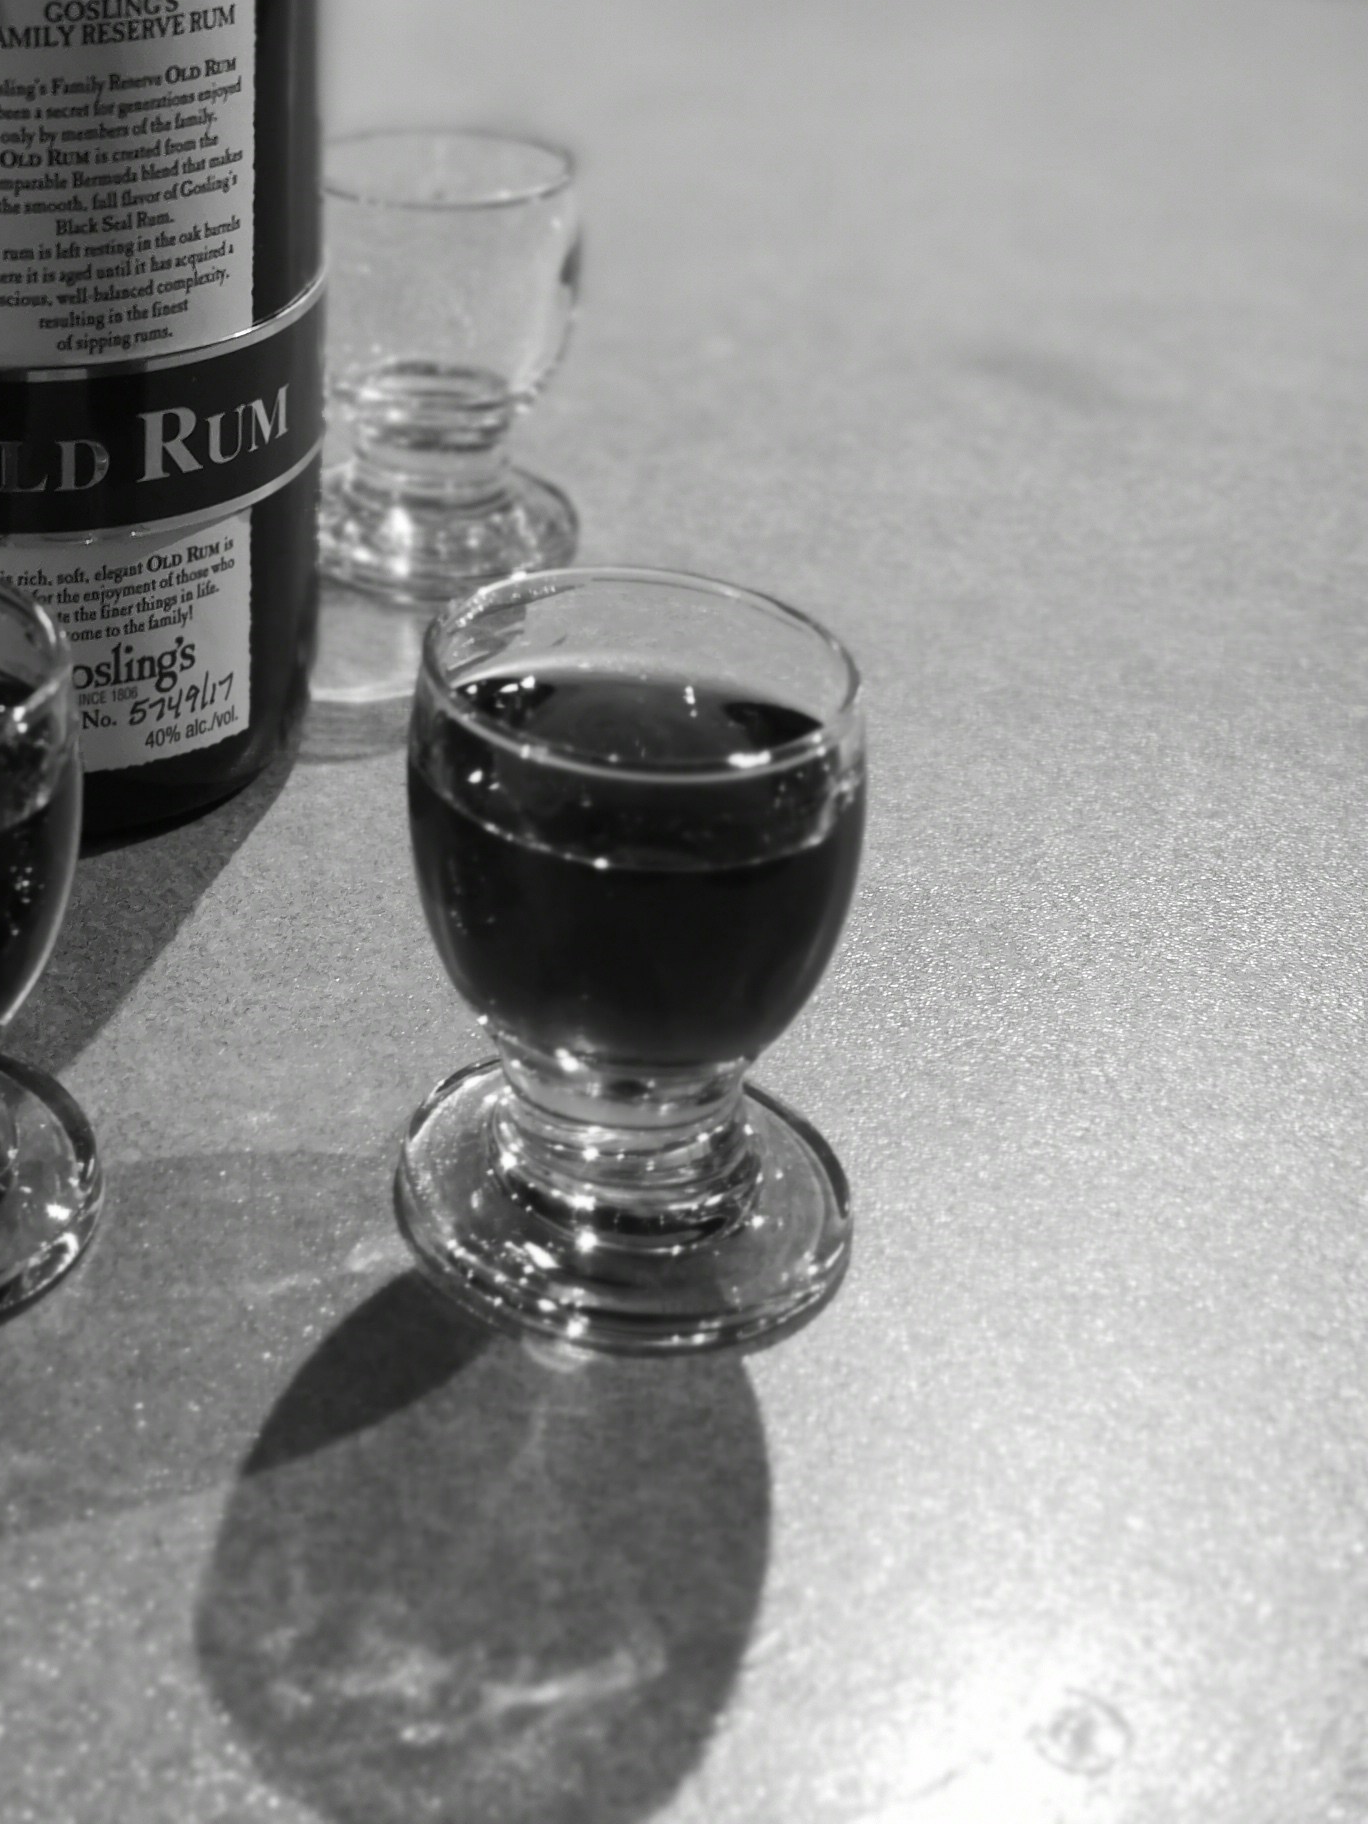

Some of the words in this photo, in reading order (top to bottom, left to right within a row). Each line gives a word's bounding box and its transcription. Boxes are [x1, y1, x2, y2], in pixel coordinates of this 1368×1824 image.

[82, 13, 185, 45] RESERVE
[189, 3, 236, 33] RUM
[34, 107, 42, 119] a
[46, 104, 90, 119] secret
[93, 100, 115, 117] for
[118, 91, 196, 119] generations
[197, 75, 242, 105] enjoyed
[50, 74, 106, 102] Family
[165, 64, 201, 84] OLD
[0, 126, 36, 151] only
[39, 124, 58, 149] by
[61, 122, 129, 143] members
[133, 117, 148, 136] of
[150, 114, 172, 133] the
[47, 148, 90, 167] RUM
[95, 147, 108, 165] is
[112, 139, 161, 163] created
[165, 137, 197, 156] from
[200, 132, 219, 149] the
[71, 166, 137, 189] Bermuda
[141, 159, 179, 182] blend
[182, 155, 206, 174] that
[209, 148, 243, 169] makes
[91, 191, 117, 210] full
[121, 189, 161, 207] flavor
[163, 181, 178, 201] of
[180, 170, 238, 197] Gosling's
[3, 248, 35, 262] rum
[39, 243, 53, 261] is
[56, 241, 82, 260] left
[84, 238, 134, 258] resting
[137, 235, 152, 253] in
[155, 230, 177, 248] the
[179, 224, 201, 244] oak
[204, 214, 241, 238] barrels
[55, 217, 99, 236] Black
[101, 212, 132, 233] Seal
[26, 266, 38, 284] it
[42, 266, 56, 284] is
[59, 262, 92, 287] aged
[95, 257, 132, 280] until
[135, 257, 146, 276] it
[150, 255, 173, 272] has
[175, 239, 226, 273] acquired
[56, 278, 154, 304] well-balanced
[39, 310, 105, 331] resulting
[109, 307, 124, 324] in
[127, 303, 150, 322] the
[152, 298, 189, 318] finest
[57, 333, 73, 352] of
[75, 330, 132, 355] sipping
[136, 383, 291, 484] RUM
[94, 563, 143, 584] elegant
[146, 553, 183, 573] OLD
[186, 541, 220, 563] RUM
[224, 536, 234, 552] is
[57, 587, 80, 604] the
[83, 579, 157, 606] enjoyment
[159, 571, 174, 589] of
[176, 568, 209, 585] those
[210, 556, 236, 574] who
[74, 606, 97, 622] the
[100, 604, 134, 620] finer
[136, 595, 178, 614] things
[181, 589, 194, 604] in
[105, 626, 121, 639] to
[123, 617, 146, 636] the
[148, 604, 193, 629] family!
[72, 636, 195, 694] osling's
[78, 690, 107, 707] INCE
[82, 708, 118, 730] No.
[145, 724, 181, 749] 40%
